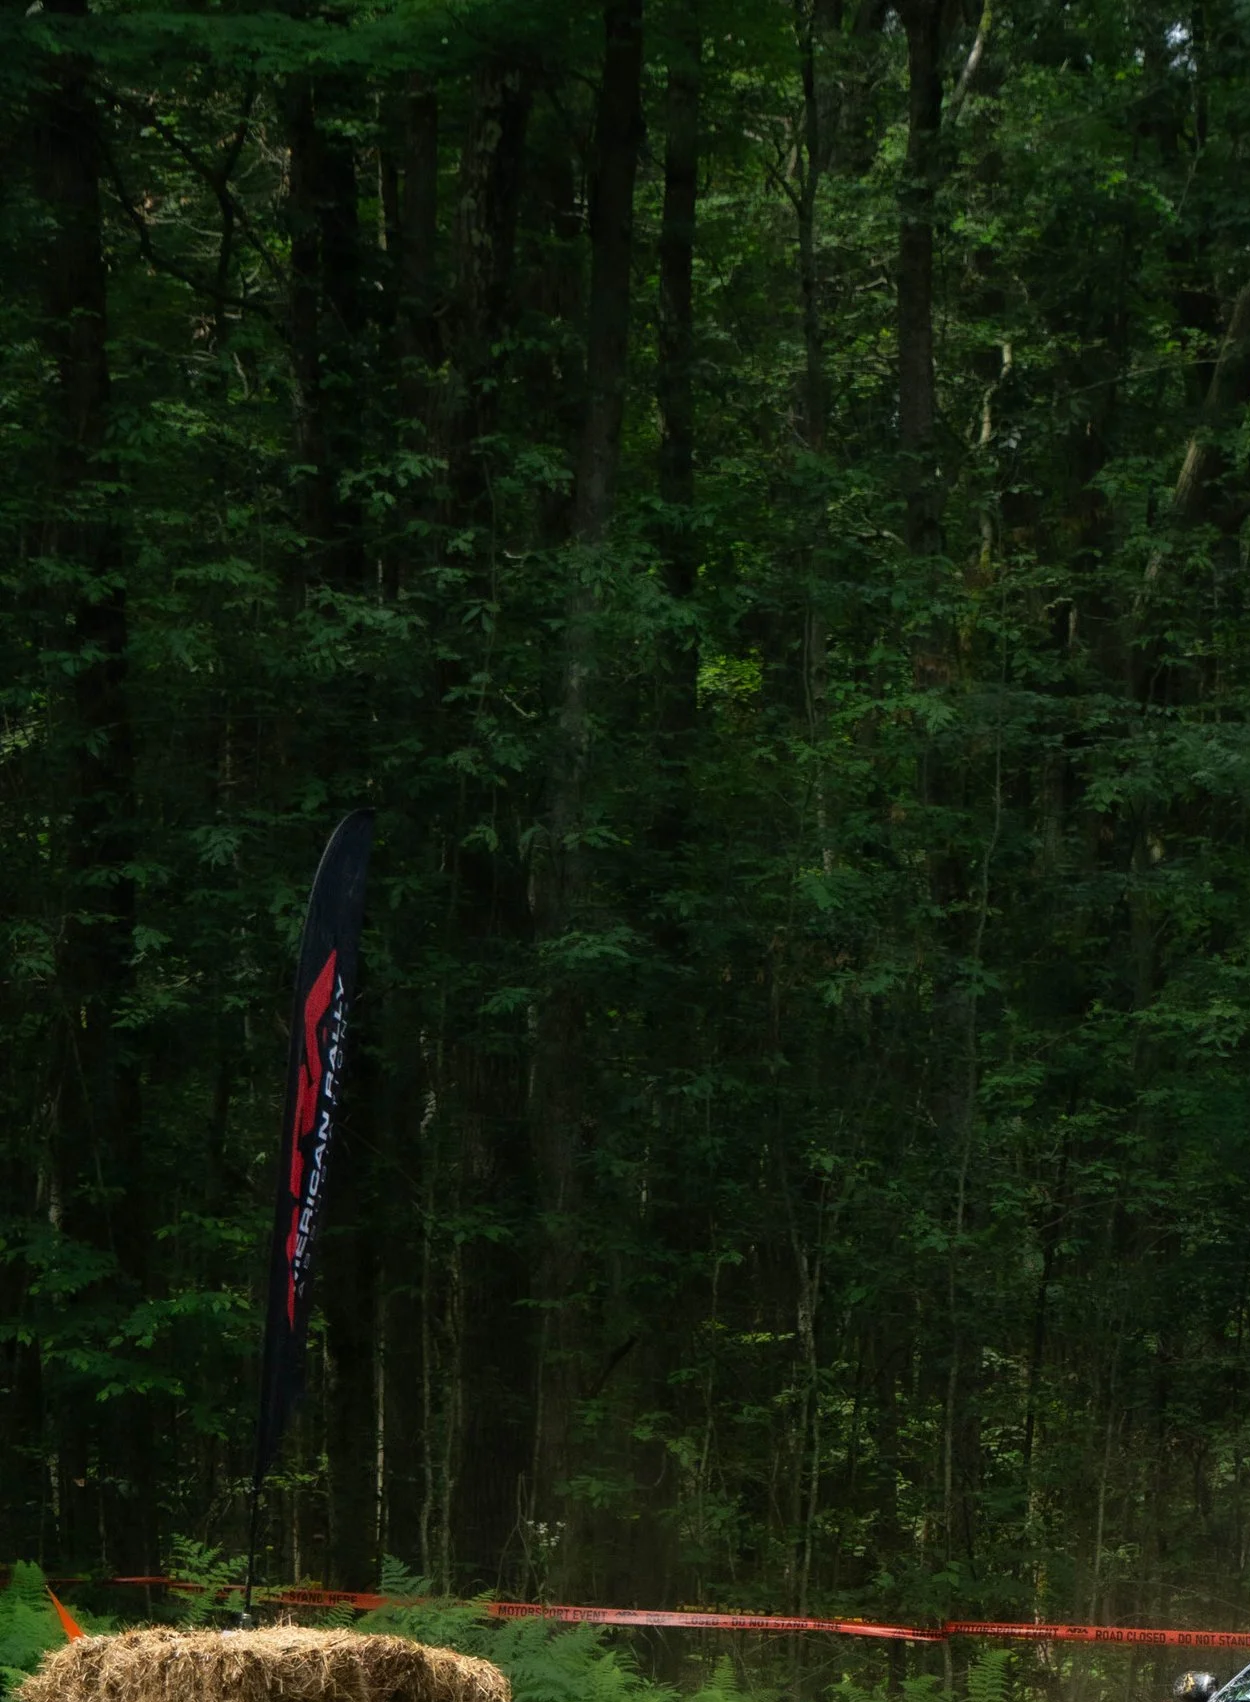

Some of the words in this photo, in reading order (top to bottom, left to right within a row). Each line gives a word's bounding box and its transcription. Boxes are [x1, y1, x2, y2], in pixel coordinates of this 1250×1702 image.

[293, 1110, 330, 1293] ERICAN
[326, 974, 344, 1097] RALLY
[289, 1590, 323, 1603] STAND
[328, 1593, 358, 1605] HERE
[498, 1604, 570, 1621] MOTORSPORT
[573, 1609, 608, 1621] EVENT
[774, 1619, 809, 1629] STAND
[1095, 1629, 1123, 1641] ROAD
[1126, 1631, 1166, 1643] CLOSED
[1178, 1633, 1192, 1644] DO
[1195, 1634, 1217, 1646] NOT
